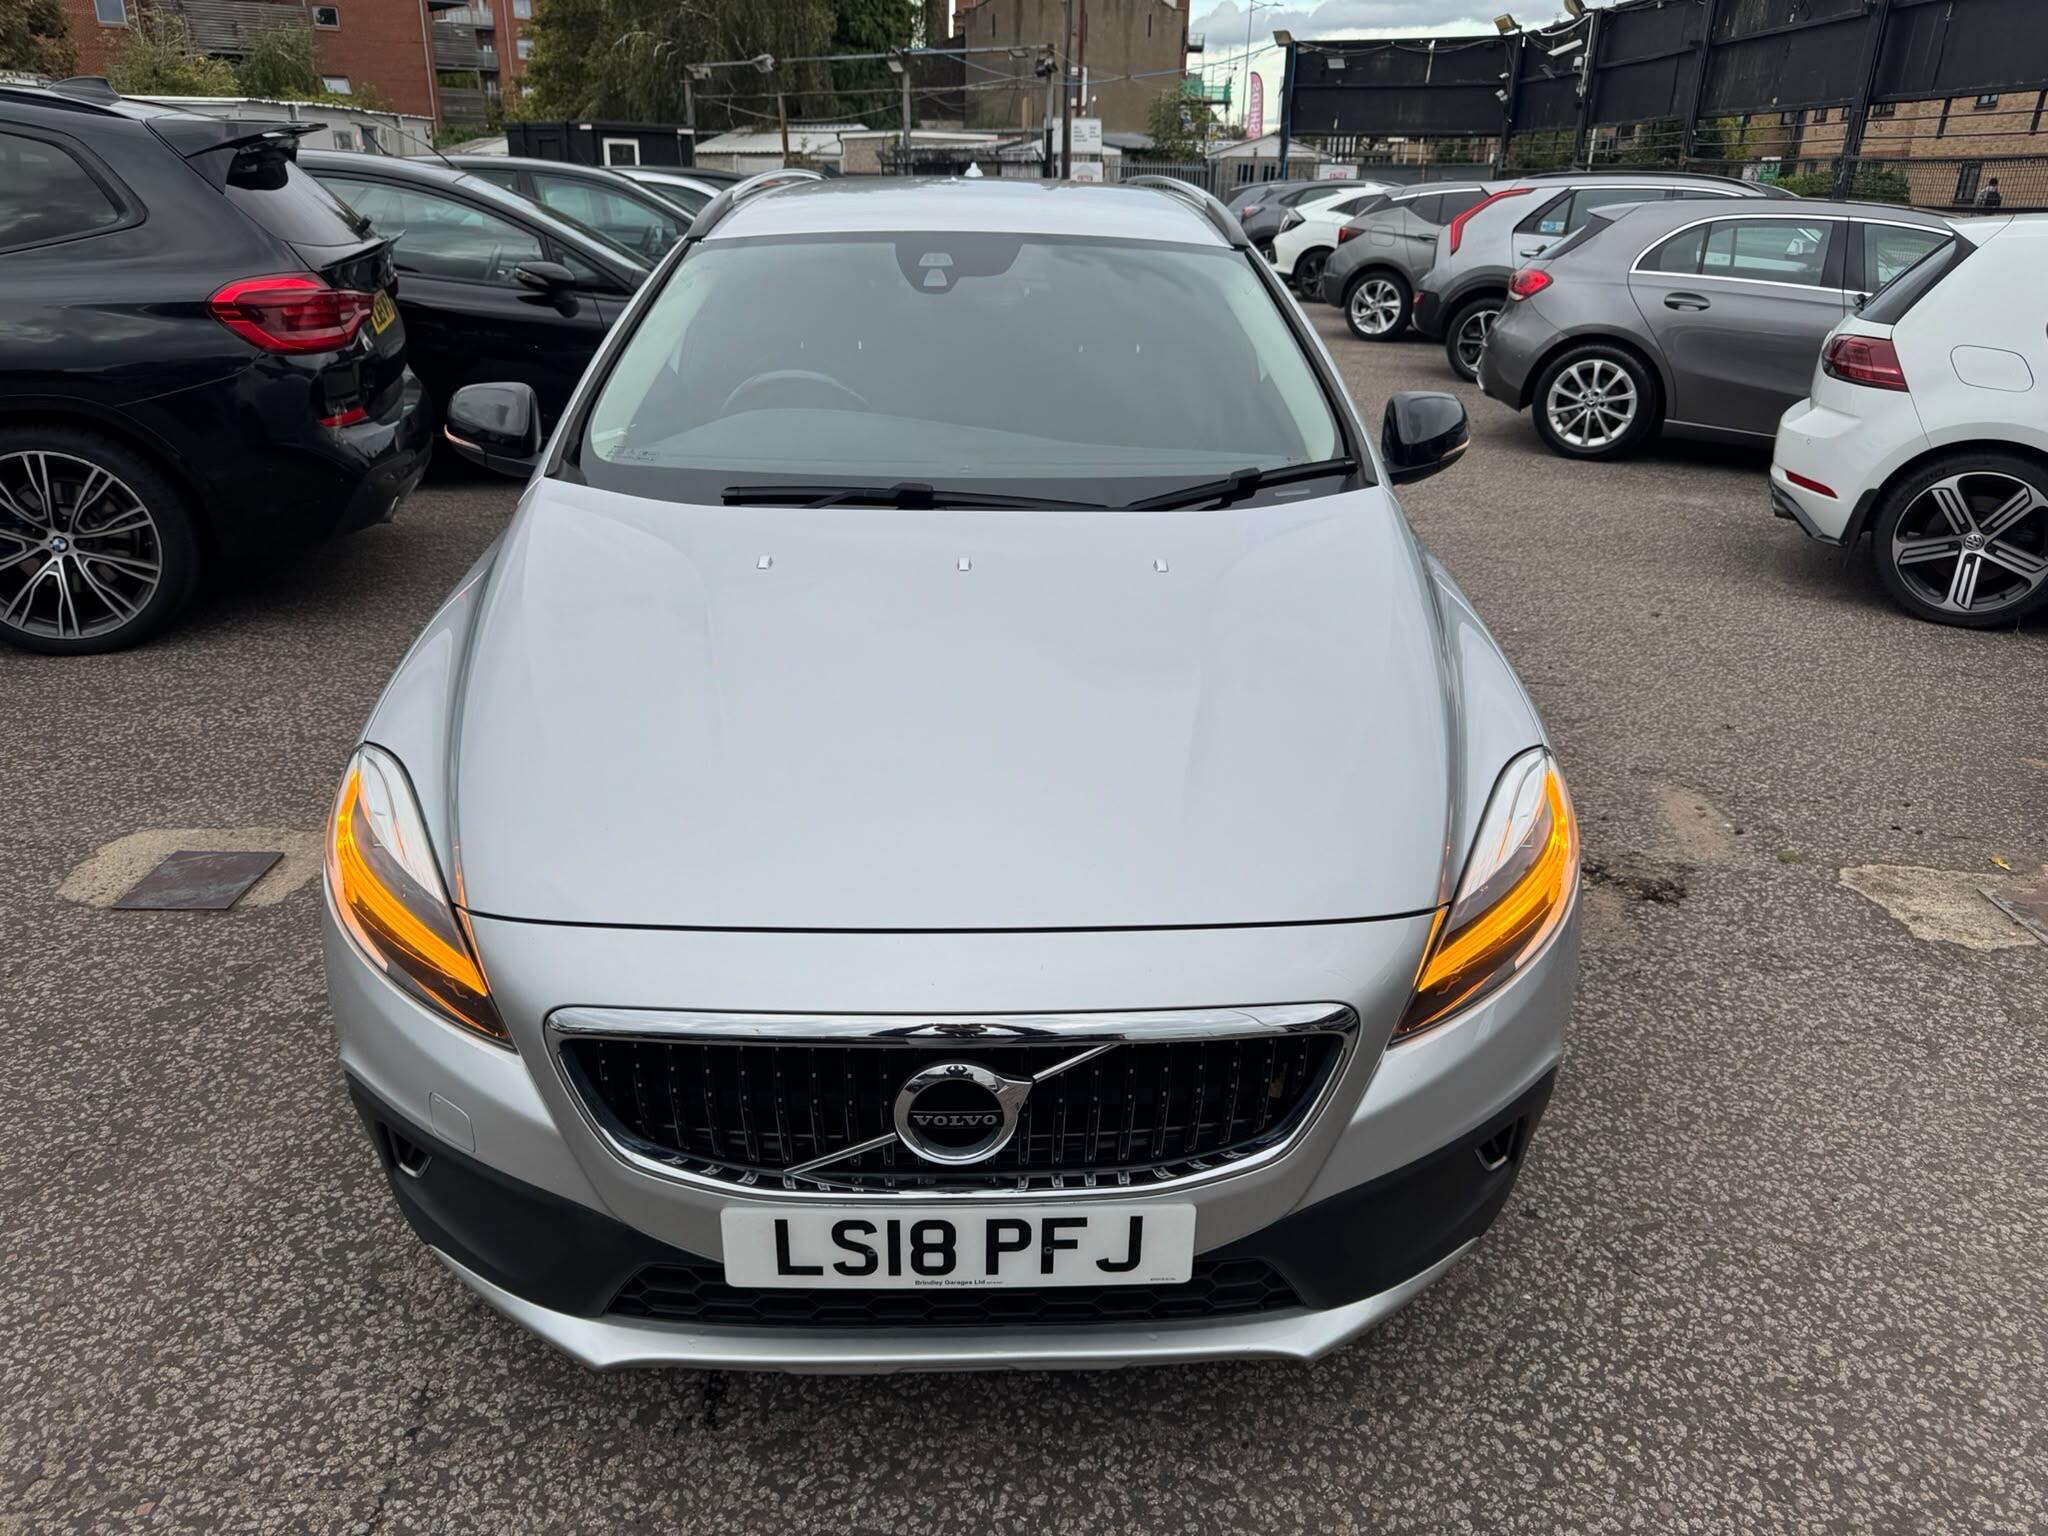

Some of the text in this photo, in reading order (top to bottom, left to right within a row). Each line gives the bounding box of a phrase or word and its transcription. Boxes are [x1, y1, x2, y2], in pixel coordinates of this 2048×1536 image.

[912, 1114, 998, 1126] VOLVO
[774, 1215, 1144, 1277] LS18 PFJ
[914, 1279, 943, 1287] Brindley
[944, 1279, 973, 1287] Garages
